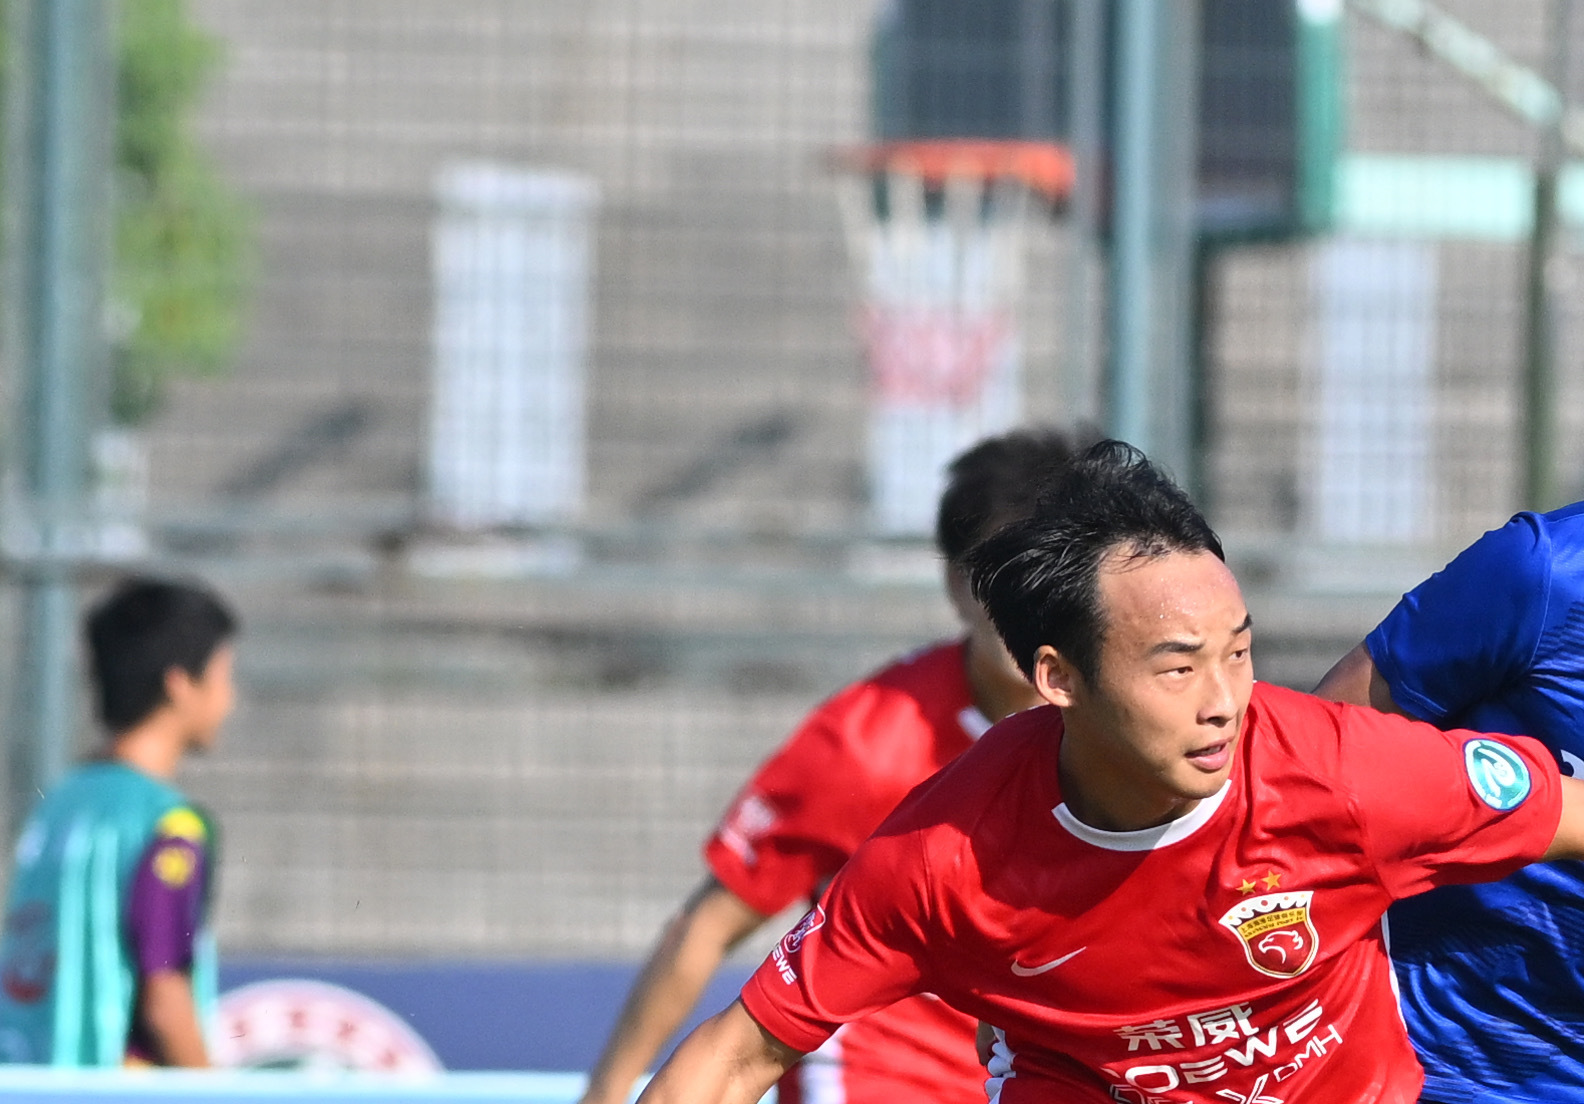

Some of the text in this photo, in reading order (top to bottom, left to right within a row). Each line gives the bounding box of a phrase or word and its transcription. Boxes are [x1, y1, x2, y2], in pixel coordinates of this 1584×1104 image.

[771, 944, 797, 985] EWE
[1100, 998, 1324, 1094] OEWE
[1113, 1002, 1260, 1051] 荣威
[1273, 1023, 1344, 1083] DMH
